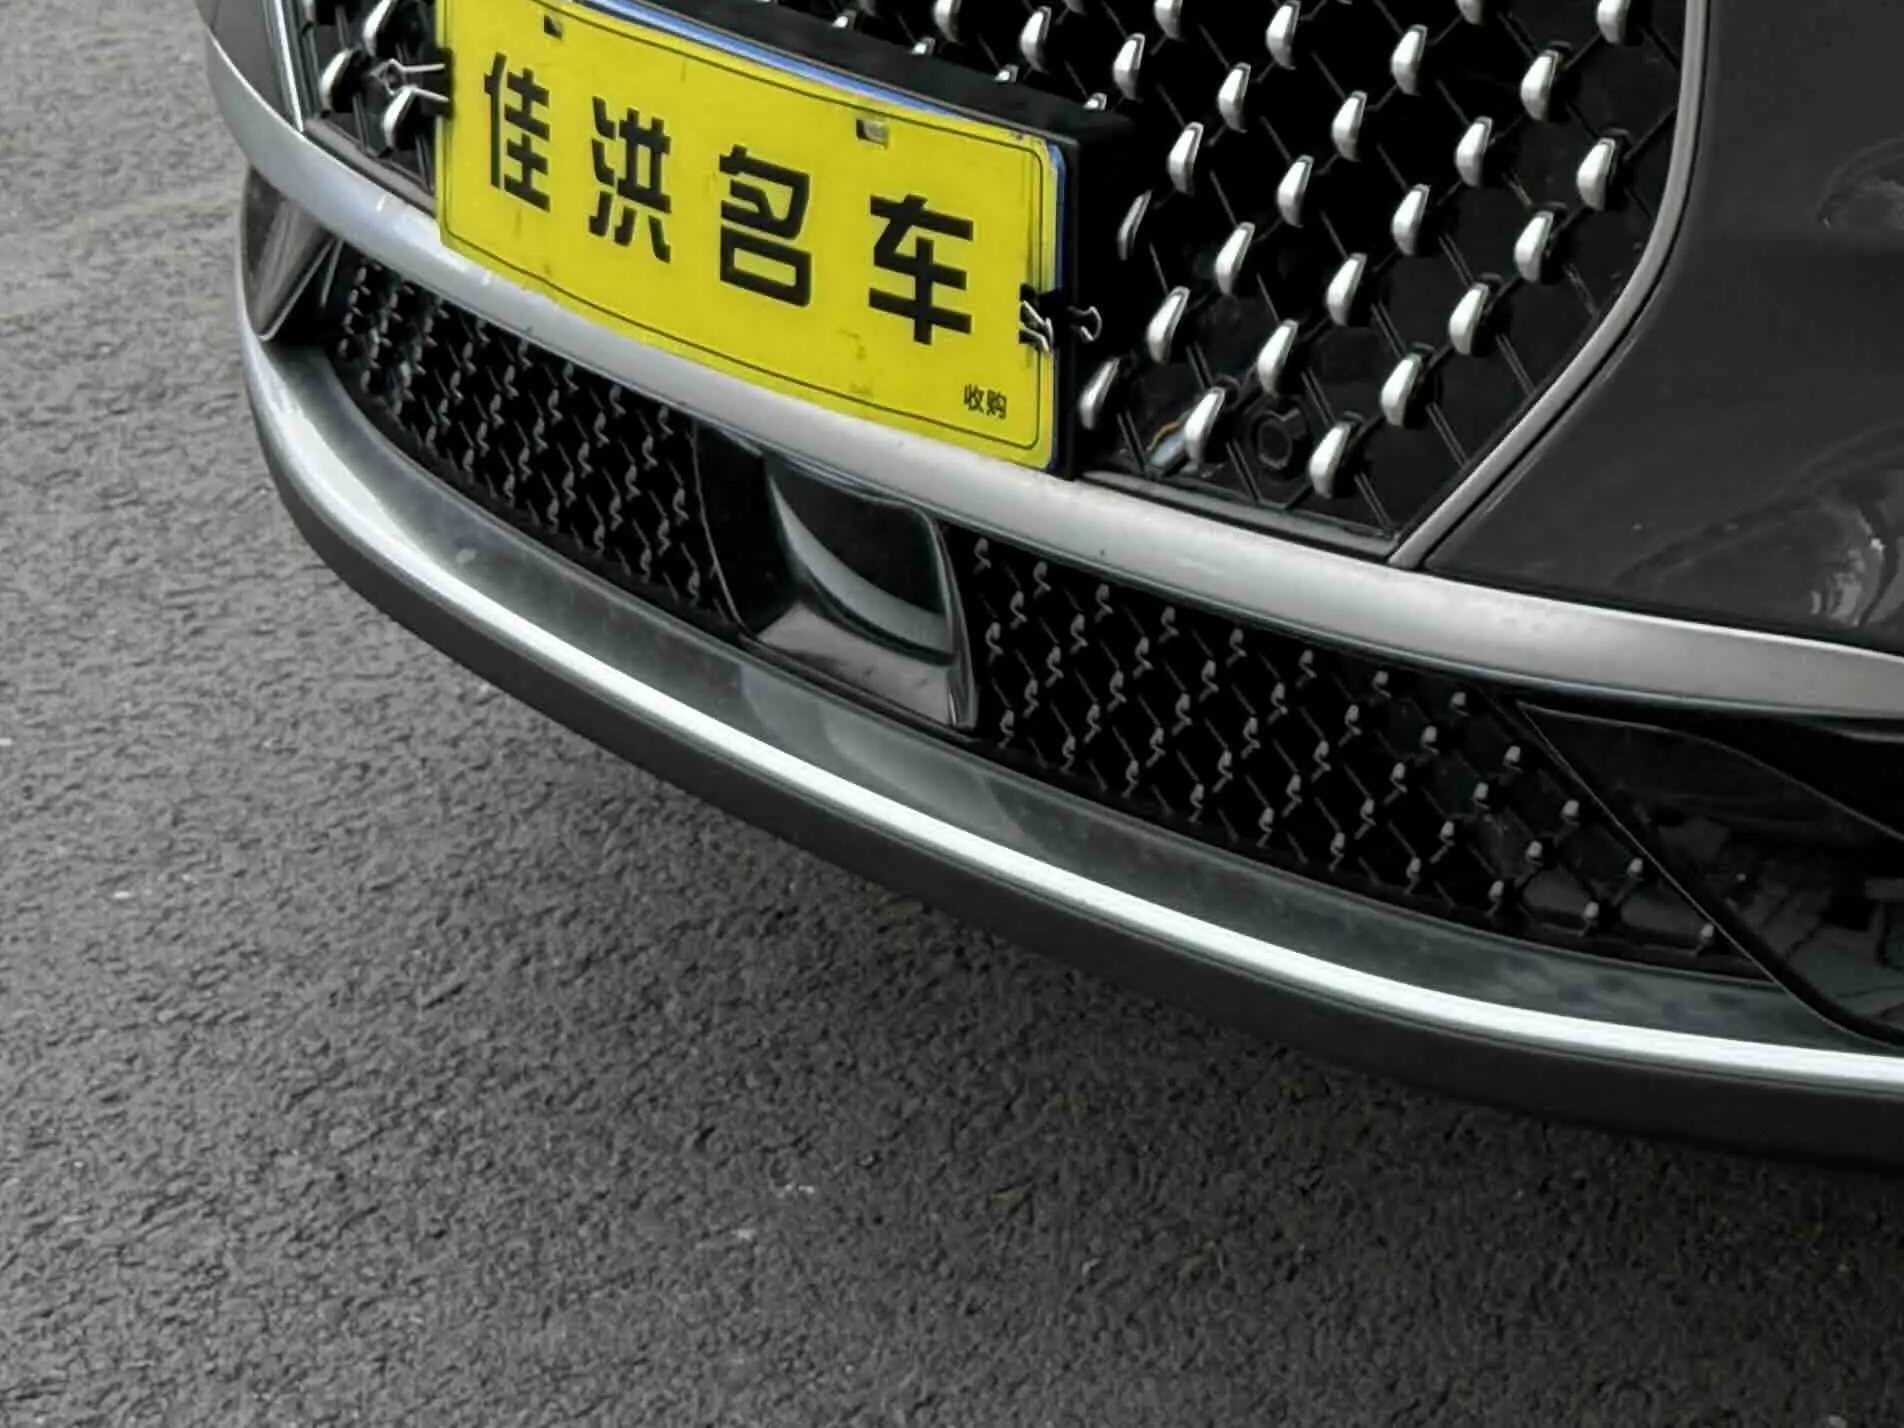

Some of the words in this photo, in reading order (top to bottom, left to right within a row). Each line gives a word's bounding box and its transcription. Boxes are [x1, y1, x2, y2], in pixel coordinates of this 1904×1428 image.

[484, 52, 974, 346] 佳洪名车
[963, 383, 1007, 419] 收购
